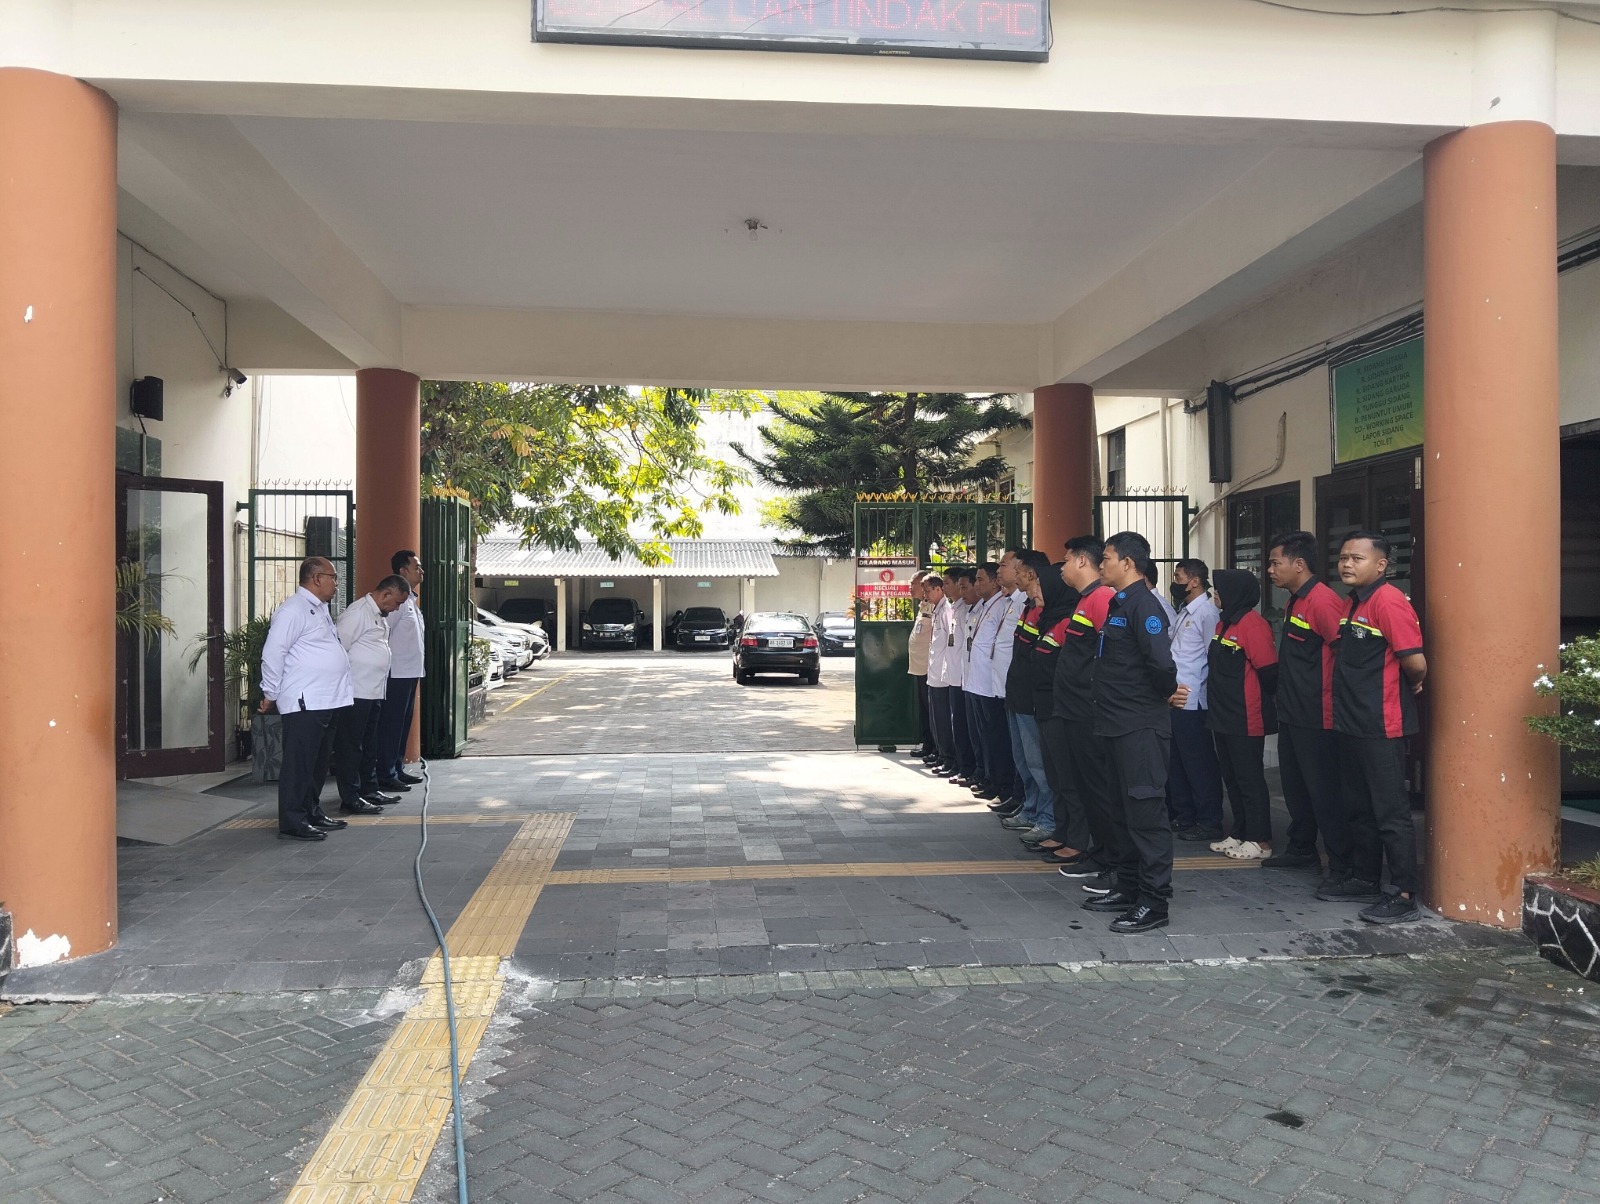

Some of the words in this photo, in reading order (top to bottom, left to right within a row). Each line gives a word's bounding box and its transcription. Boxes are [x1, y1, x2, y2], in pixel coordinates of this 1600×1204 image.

[1365, 360, 1385, 372] SIDANG
[1386, 352, 1408, 365] UTAMA
[1362, 379, 1383, 393] SIDANG
[1385, 371, 1410, 385] KARTIKA
[1368, 369, 1389, 381] SIDANG
[1390, 364, 1404, 373] SARI
[1362, 389, 1384, 402] SIDANG
[1385, 381, 1410, 395] GARUDA
[1362, 399, 1387, 412] TUNGGU
[1388, 391, 1410, 404] SIDANG
[1361, 408, 1391, 422] PENUNTUT
[1392, 401, 1413, 413] UMUM
[1365, 417, 1394, 430] WORKING
[1395, 412, 1414, 423] SPACE
[1362, 430, 1381, 441] LAPOR
[1382, 424, 1404, 436] SIDANG
[1373, 437, 1392, 448] TOILET
